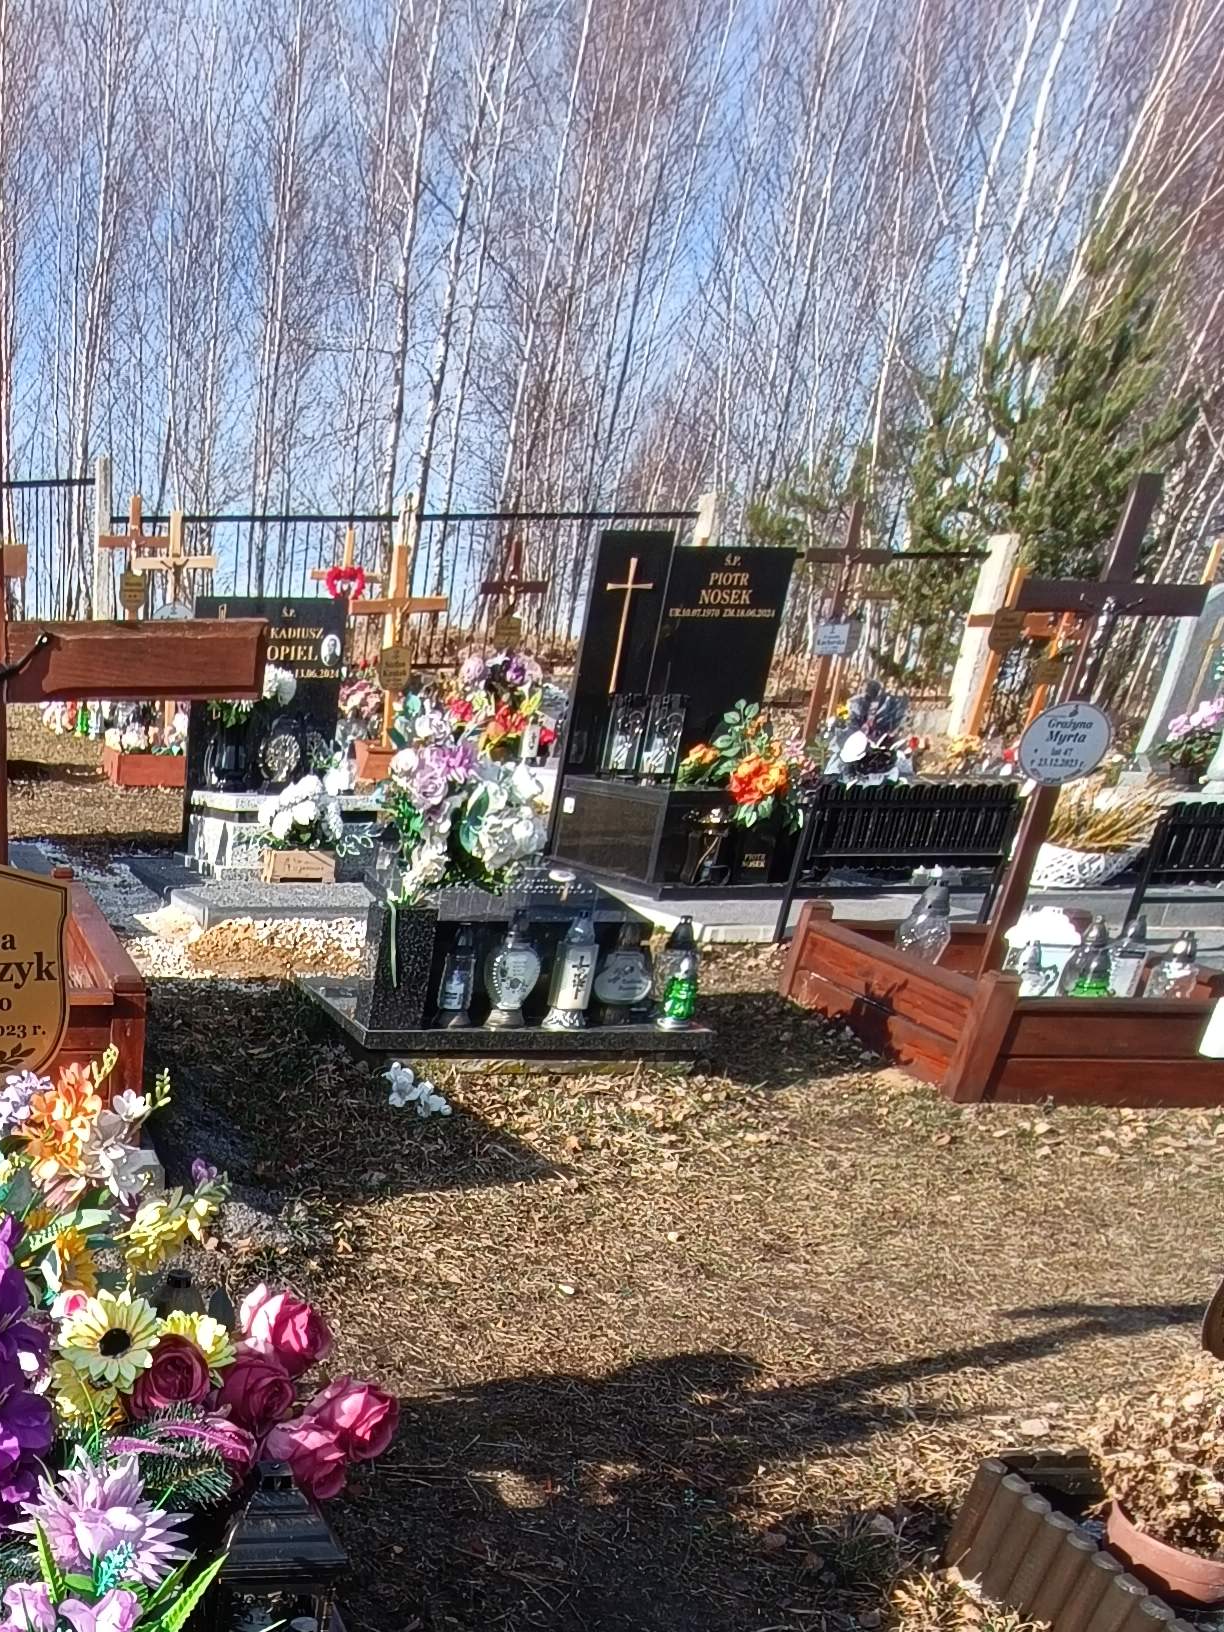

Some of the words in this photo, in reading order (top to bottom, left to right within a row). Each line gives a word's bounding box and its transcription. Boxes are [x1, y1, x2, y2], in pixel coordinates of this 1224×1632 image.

[708, 572, 750, 587] PIOTR
[698, 589, 753, 605] NOSEK
[269, 626, 324, 640] KADIUSZ
[266, 645, 318, 662] OPIEL
[1048, 719, 1094, 732] Grażyna
[1045, 730, 1087, 746] Myrta
[31, 1024, 47, 1037] r.
